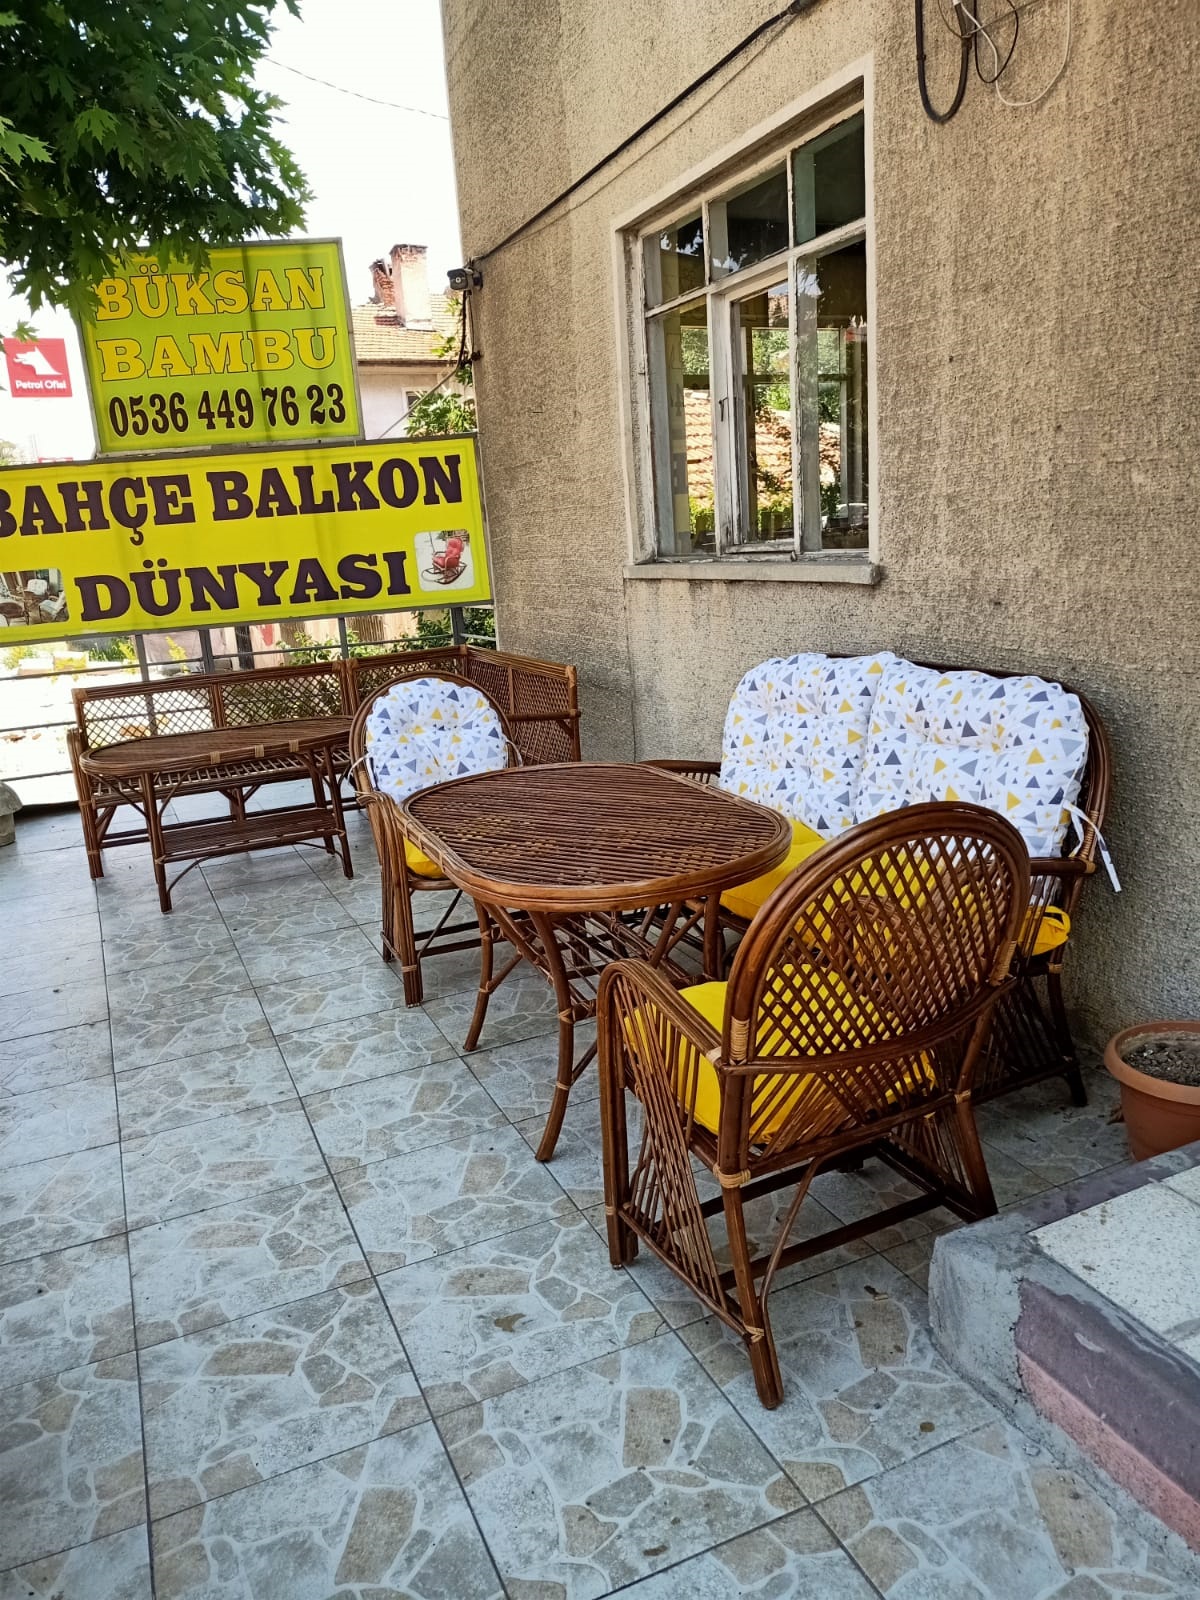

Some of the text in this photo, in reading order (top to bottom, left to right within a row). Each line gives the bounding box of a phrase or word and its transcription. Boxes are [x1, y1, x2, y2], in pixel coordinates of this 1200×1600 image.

[96, 264, 325, 321] BÜKSAN
[96, 327, 337, 382] BAMBU
[15, 380, 43, 389] Petrol
[109, 383, 346, 437] 0536 449 76 23
[205, 455, 462, 522] BALKON
[74, 551, 411, 622] DÜNYASI
